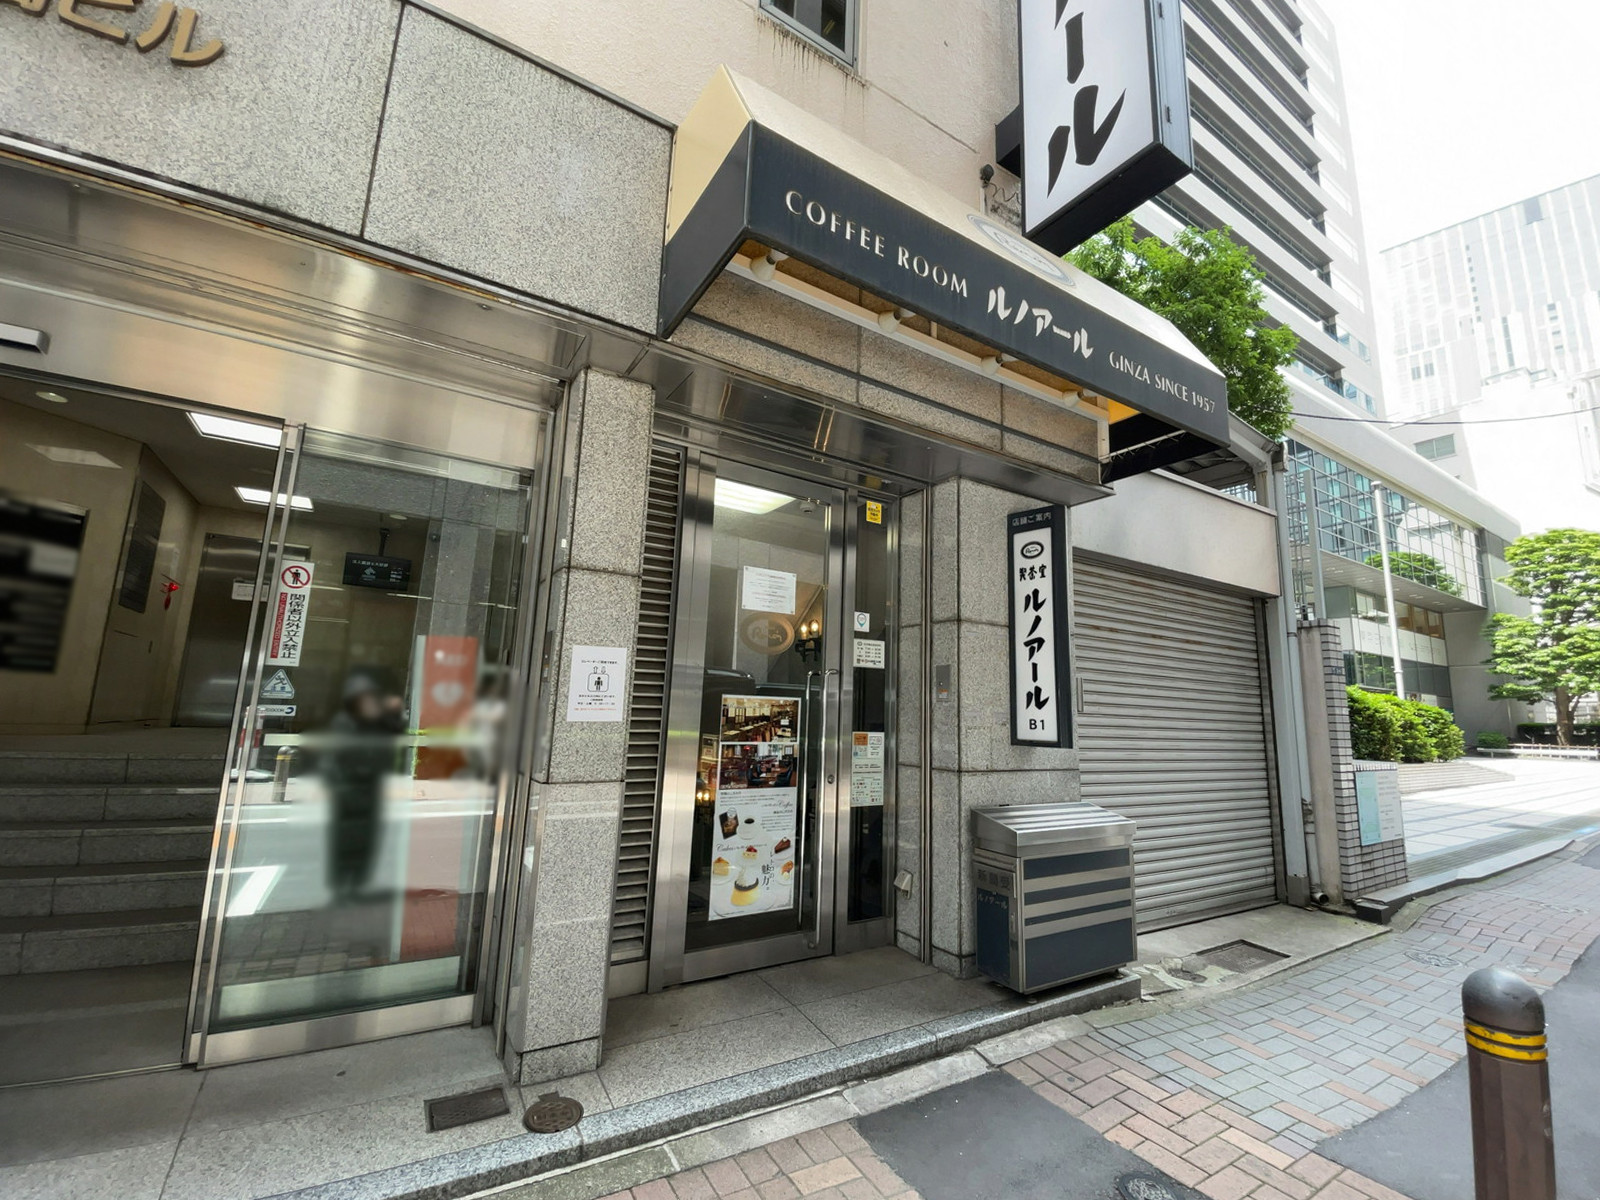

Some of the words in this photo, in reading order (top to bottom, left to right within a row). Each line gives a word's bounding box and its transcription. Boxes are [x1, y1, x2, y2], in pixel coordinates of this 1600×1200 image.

[1047, 0, 1127, 199] ール
[785, 190, 885, 258] COFFEE
[897, 245, 968, 298] ROOM
[986, 285, 1094, 360] ルノアール
[1109, 351, 1151, 385] GINZA
[1154, 373, 1189, 402] SINCE
[1191, 391, 1216, 414] 1957
[1019, 563, 1047, 582] 喫茶室
[280, 593, 306, 660] 関係者以外立入禁止
[1023, 588, 1050, 711] ルノアール
[1028, 718, 1046, 731] B1
